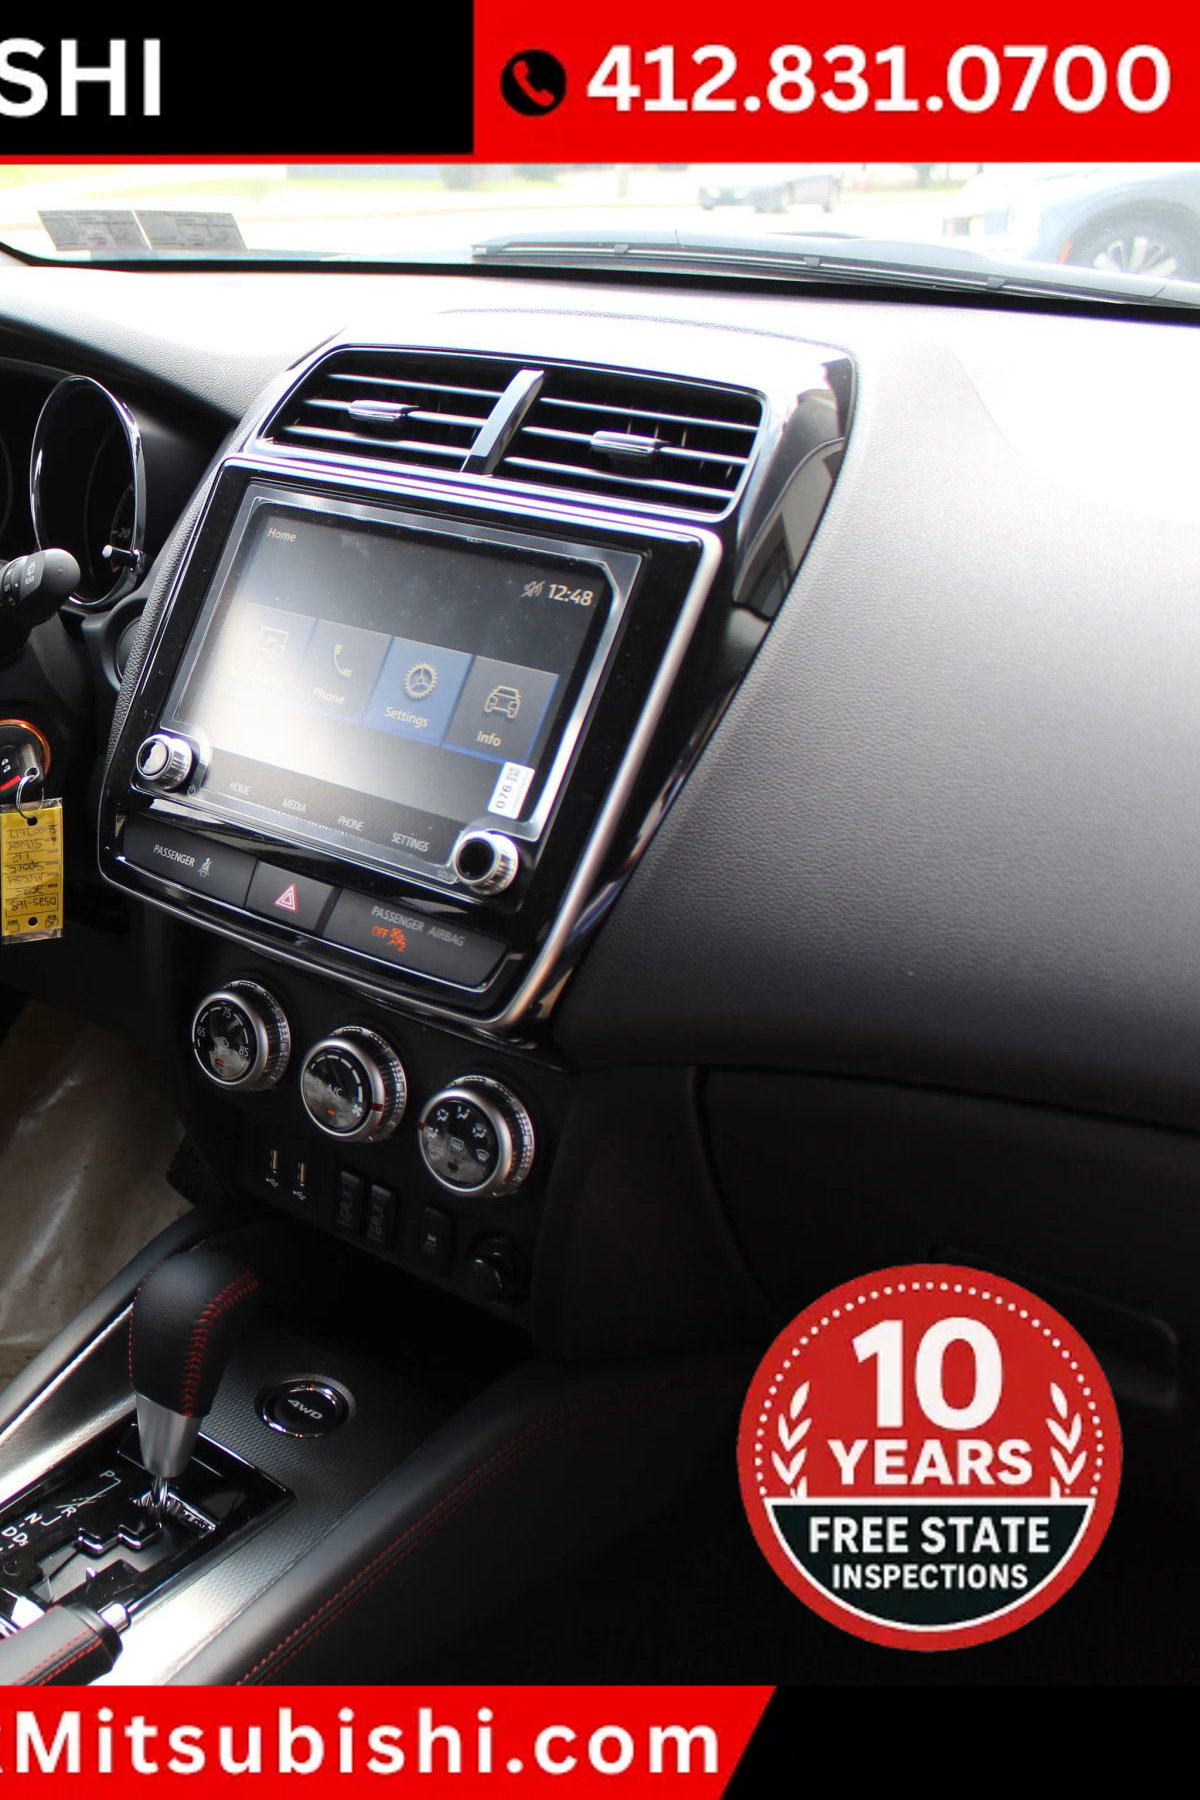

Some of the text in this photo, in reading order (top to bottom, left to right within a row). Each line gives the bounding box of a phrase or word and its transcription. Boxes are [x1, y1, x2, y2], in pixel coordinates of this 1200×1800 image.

[268, 527, 296, 543] Home
[547, 583, 595, 606] 12:48
[312, 687, 346, 705] Phone
[383, 706, 429, 729] Settings
[476, 730, 502, 747] Info
[229, 781, 430, 853] HOME MEDIA PHONE SETTINGS
[153, 844, 196, 867] PASSENGER
[371, 906, 466, 946] PASSENGER AIRBAG
[371, 925, 390, 939] OFF
[223, 1007, 233, 1019] 75
[238, 1044, 249, 1057] 85
[327, 1083, 343, 1098] A/C
[287, 1399, 323, 1420] 4WD
[99, 1469, 116, 1480] P
[24, 1511, 43, 1526] N
[60, 1504, 77, 1518] R
